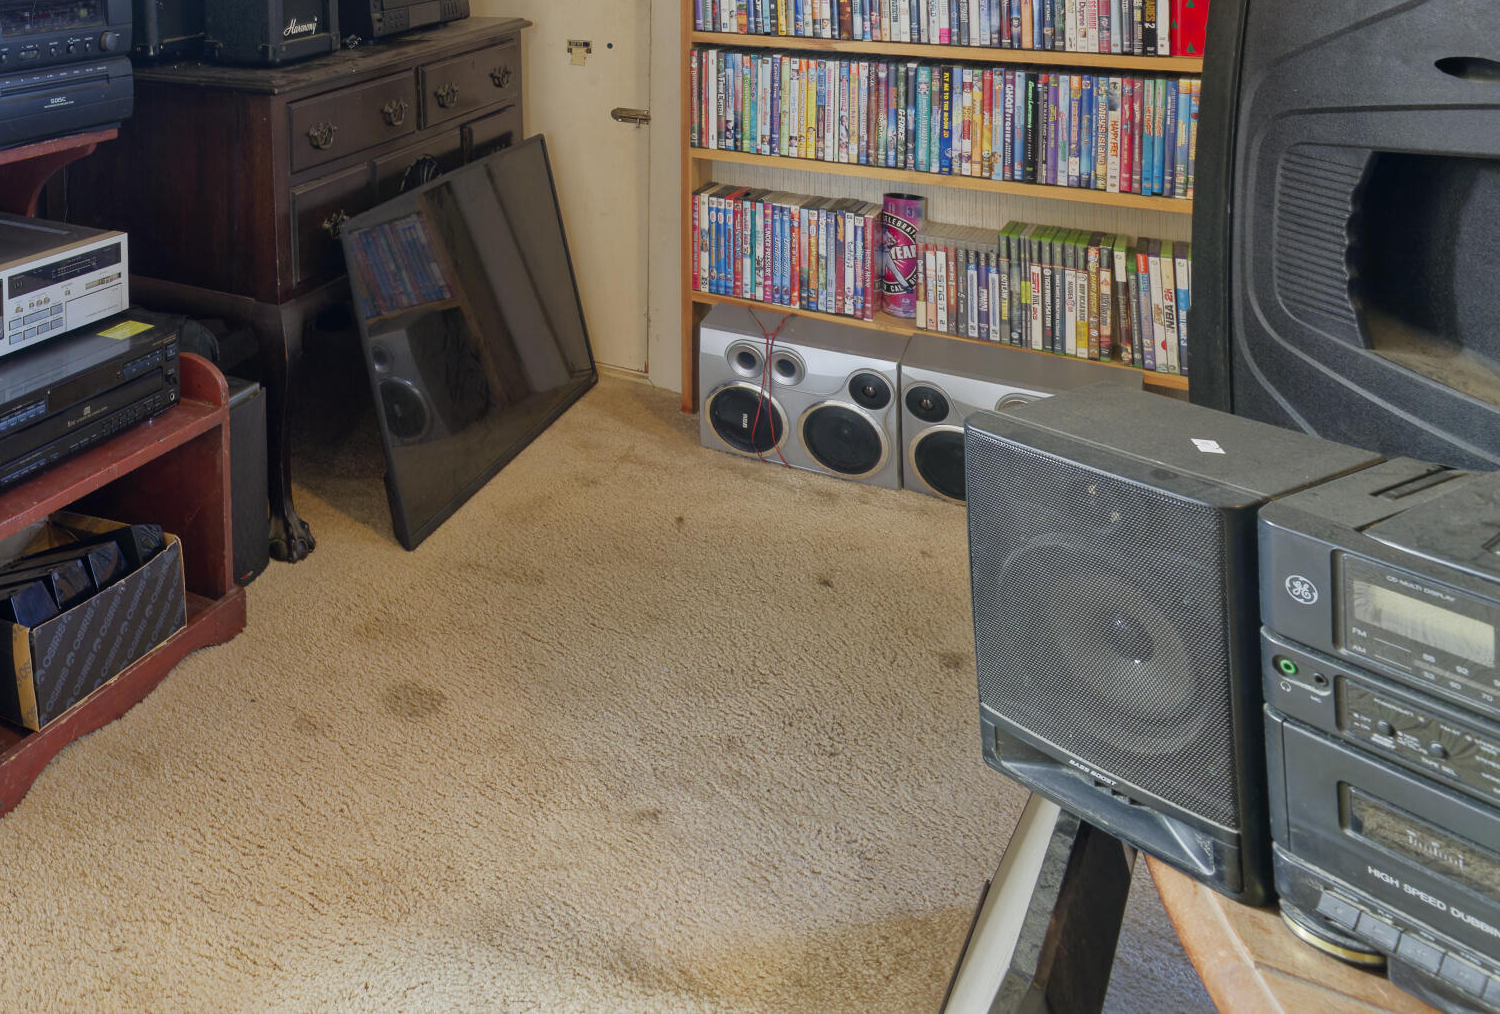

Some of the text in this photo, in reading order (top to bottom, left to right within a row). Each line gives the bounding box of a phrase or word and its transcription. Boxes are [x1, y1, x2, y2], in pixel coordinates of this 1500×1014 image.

[1077, 1, 1085, 26] Dupree
[283, 16, 318, 37] Harmony
[943, 82, 948, 91] ME
[1109, 120, 1118, 157] HAPPY FEET
[1164, 304, 1174, 329] NBA
[1386, 574, 1456, 603] CD MULTI DISPLAY
[1352, 626, 1367, 638] FM
[1352, 644, 1367, 654] AM
[1481, 692, 1494, 702] 70
[1367, 865, 1400, 889] HIGH
[1403, 883, 1447, 912] SPEED
